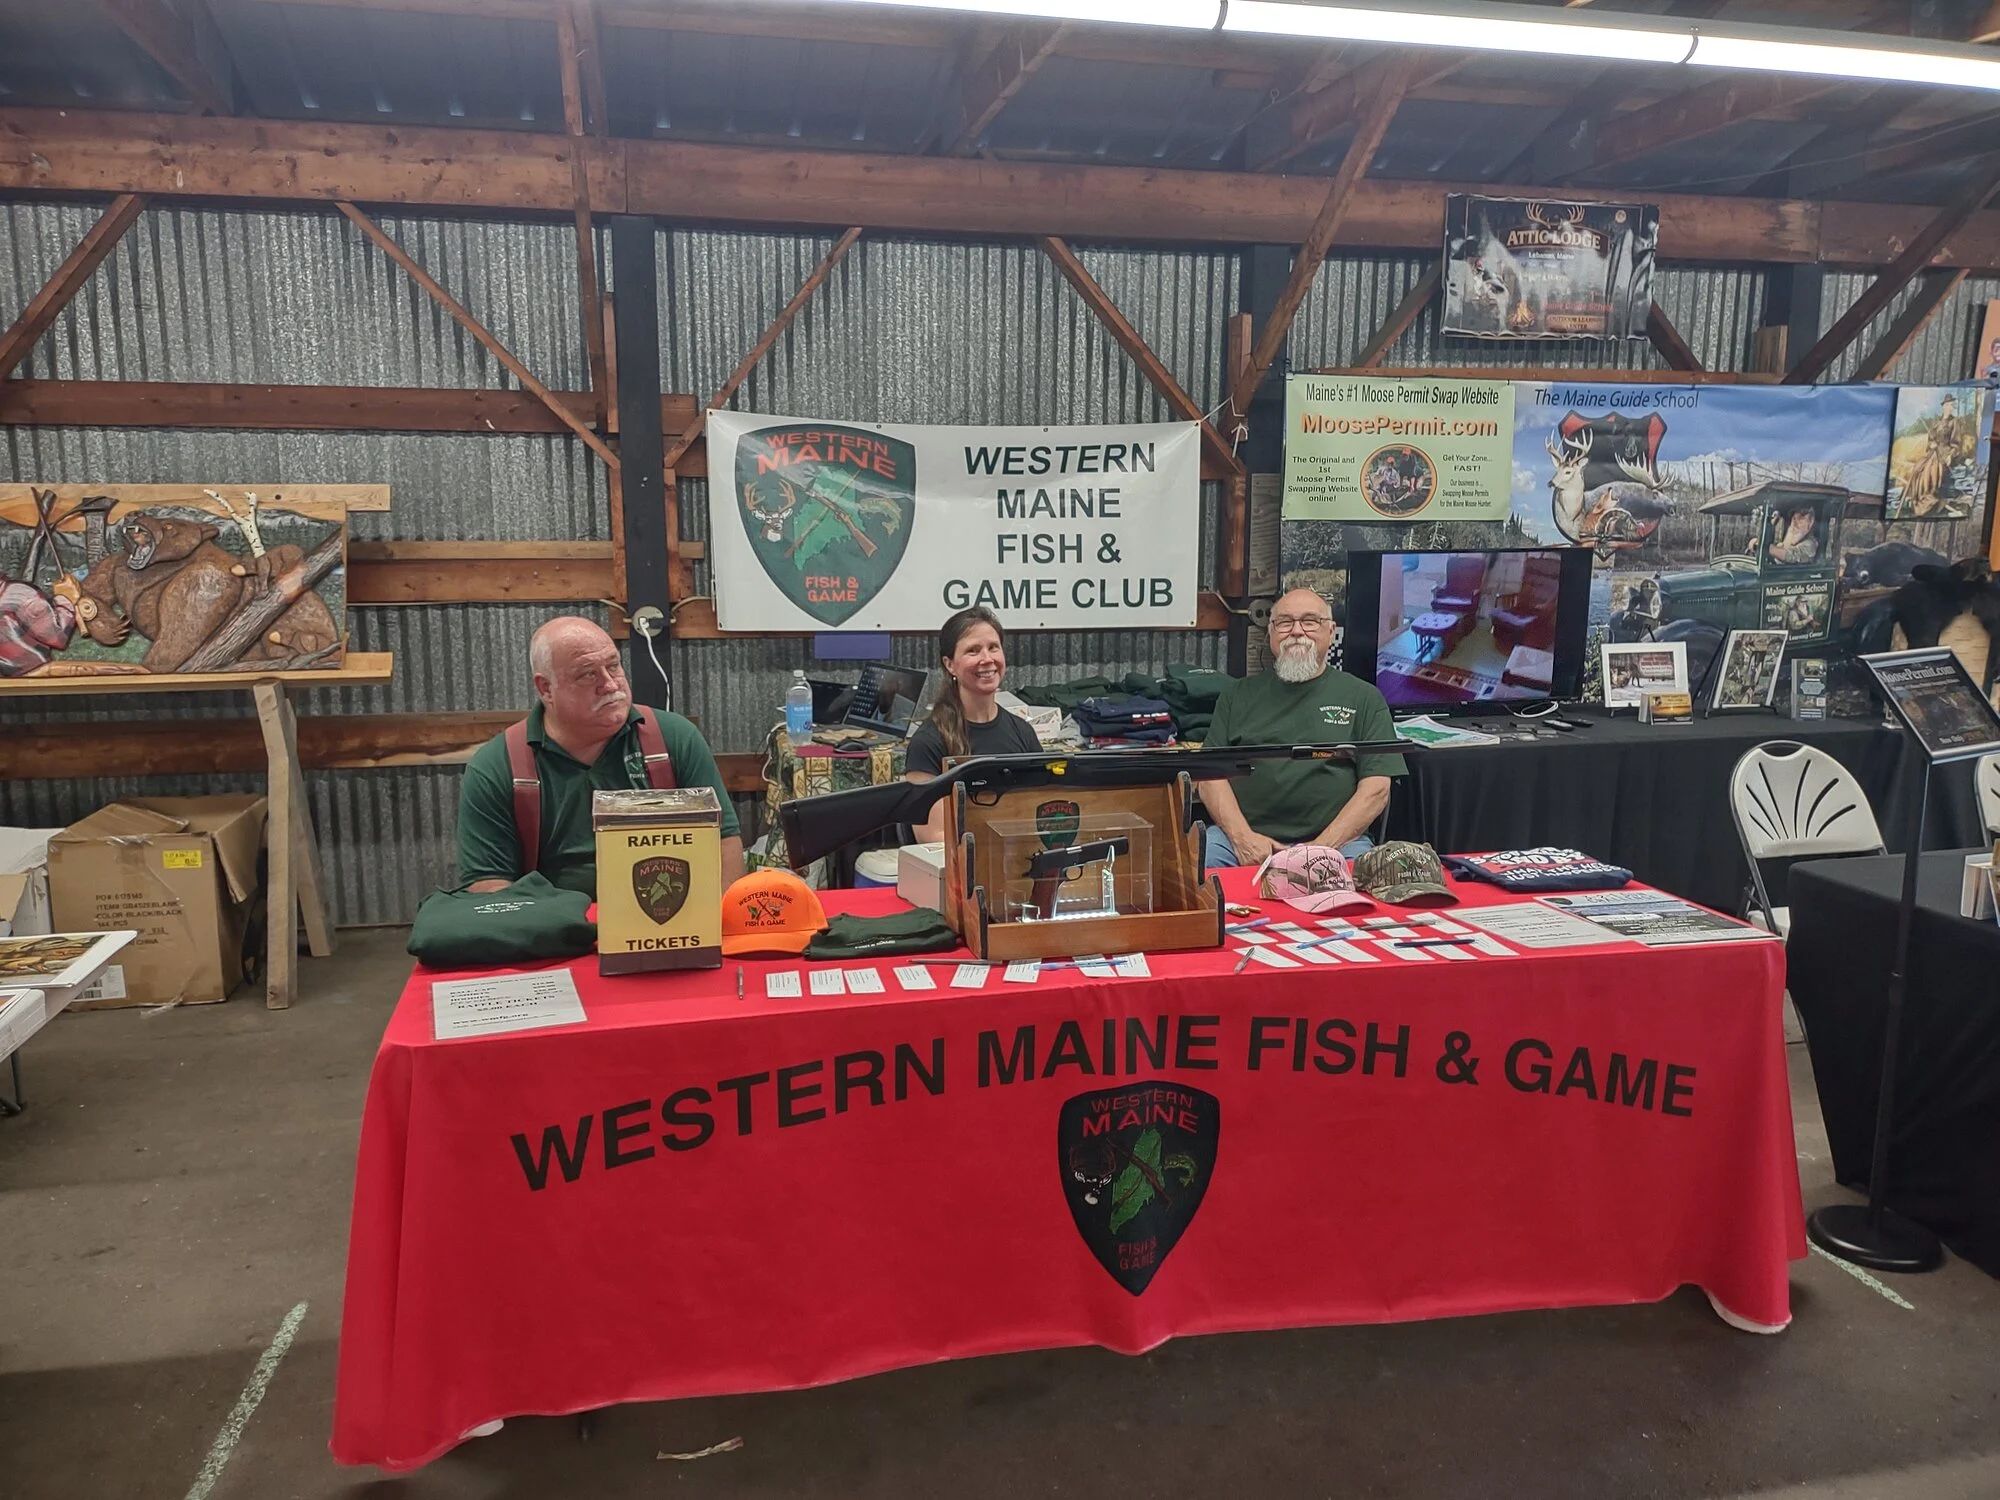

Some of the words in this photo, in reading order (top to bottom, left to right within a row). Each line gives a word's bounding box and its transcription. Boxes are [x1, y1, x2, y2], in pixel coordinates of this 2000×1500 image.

[1506, 229, 1550, 247] ATTIC
[1552, 230, 1601, 250] LODGE
[1306, 383, 1344, 402] Maine's
[1346, 384, 1359, 401] #1
[1361, 384, 1394, 402] Moose
[1397, 385, 1430, 404] Permit
[1431, 386, 1459, 408] Swap
[1461, 386, 1499, 404] Website
[1535, 388, 1560, 406] The
[1563, 389, 1605, 408] Maine
[1609, 391, 1650, 408] Guide
[1653, 391, 1700, 409] School
[1302, 413, 1498, 437] MoosePermit.com
[766, 432, 888, 457] WESTERN
[757, 444, 896, 480] MAINE
[964, 442, 1155, 475] WESTERN
[1309, 456, 1340, 465] Original
[1442, 454, 1455, 462] Get
[1456, 454, 1470, 462] Your
[1288, 485, 1326, 494] Swapping
[1328, 485, 1359, 493] Website
[1297, 475, 1323, 483] Moose
[1325, 475, 1351, 483] Permit
[996, 487, 1122, 518] MAINE
[996, 533, 1083, 564] FISH
[1096, 533, 1122, 563] &
[805, 576, 841, 588] FISH
[846, 576, 859, 588] &
[1766, 586, 1786, 596] Maine
[1787, 584, 1805, 594] Guide
[1806, 583, 1828, 593] School
[807, 589, 858, 603] GAME
[942, 579, 1058, 610] GAME
[1071, 578, 1174, 608] CLUB
[627, 833, 694, 847] RAFFLE
[640, 864, 684, 876] MAINE
[738, 890, 769, 906] WESTERN
[771, 890, 794, 904] MAINE
[745, 920, 759, 928] FISH
[626, 935, 701, 951] TICKETS
[510, 1037, 946, 1192] WESTERN
[977, 1014, 1221, 1088] MAINE
[1247, 1016, 1411, 1078] FISH
[1436, 1030, 1480, 1085] &
[1504, 1038, 1697, 1117] GAME
[1091, 1088, 1193, 1114] WESTERN
[1082, 1105, 1199, 1138] MAINE
